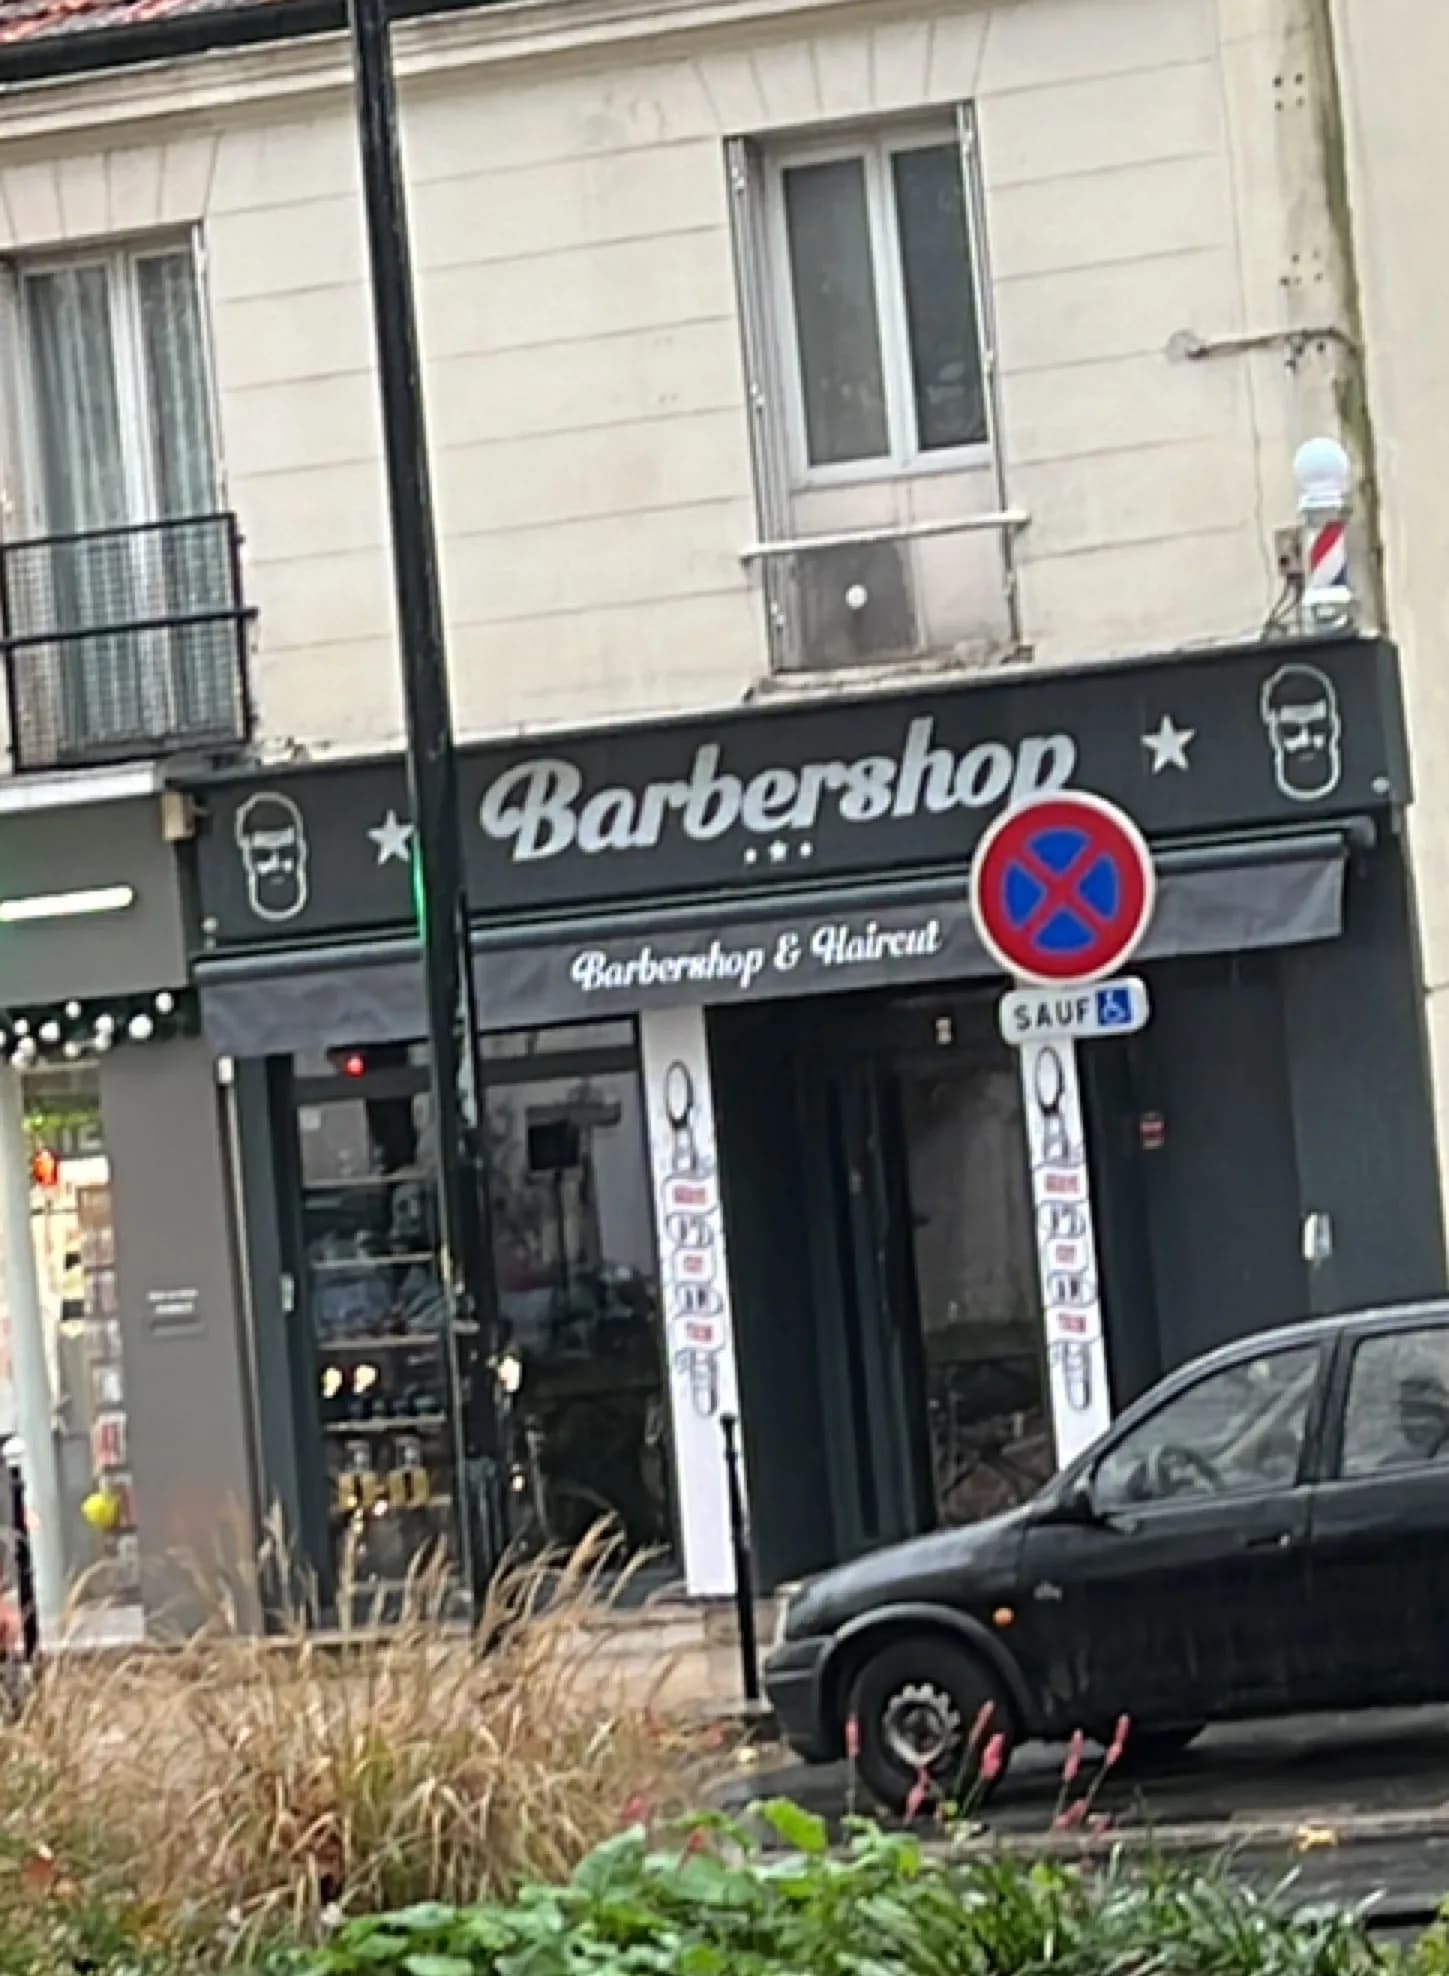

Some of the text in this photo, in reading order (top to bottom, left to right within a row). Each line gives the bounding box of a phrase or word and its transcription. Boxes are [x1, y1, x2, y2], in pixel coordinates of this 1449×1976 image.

[480, 716, 1076, 862] Barbershop
[570, 919, 941, 991] Barbershop & Haircut
[1013, 996, 1090, 1032] SAUF
